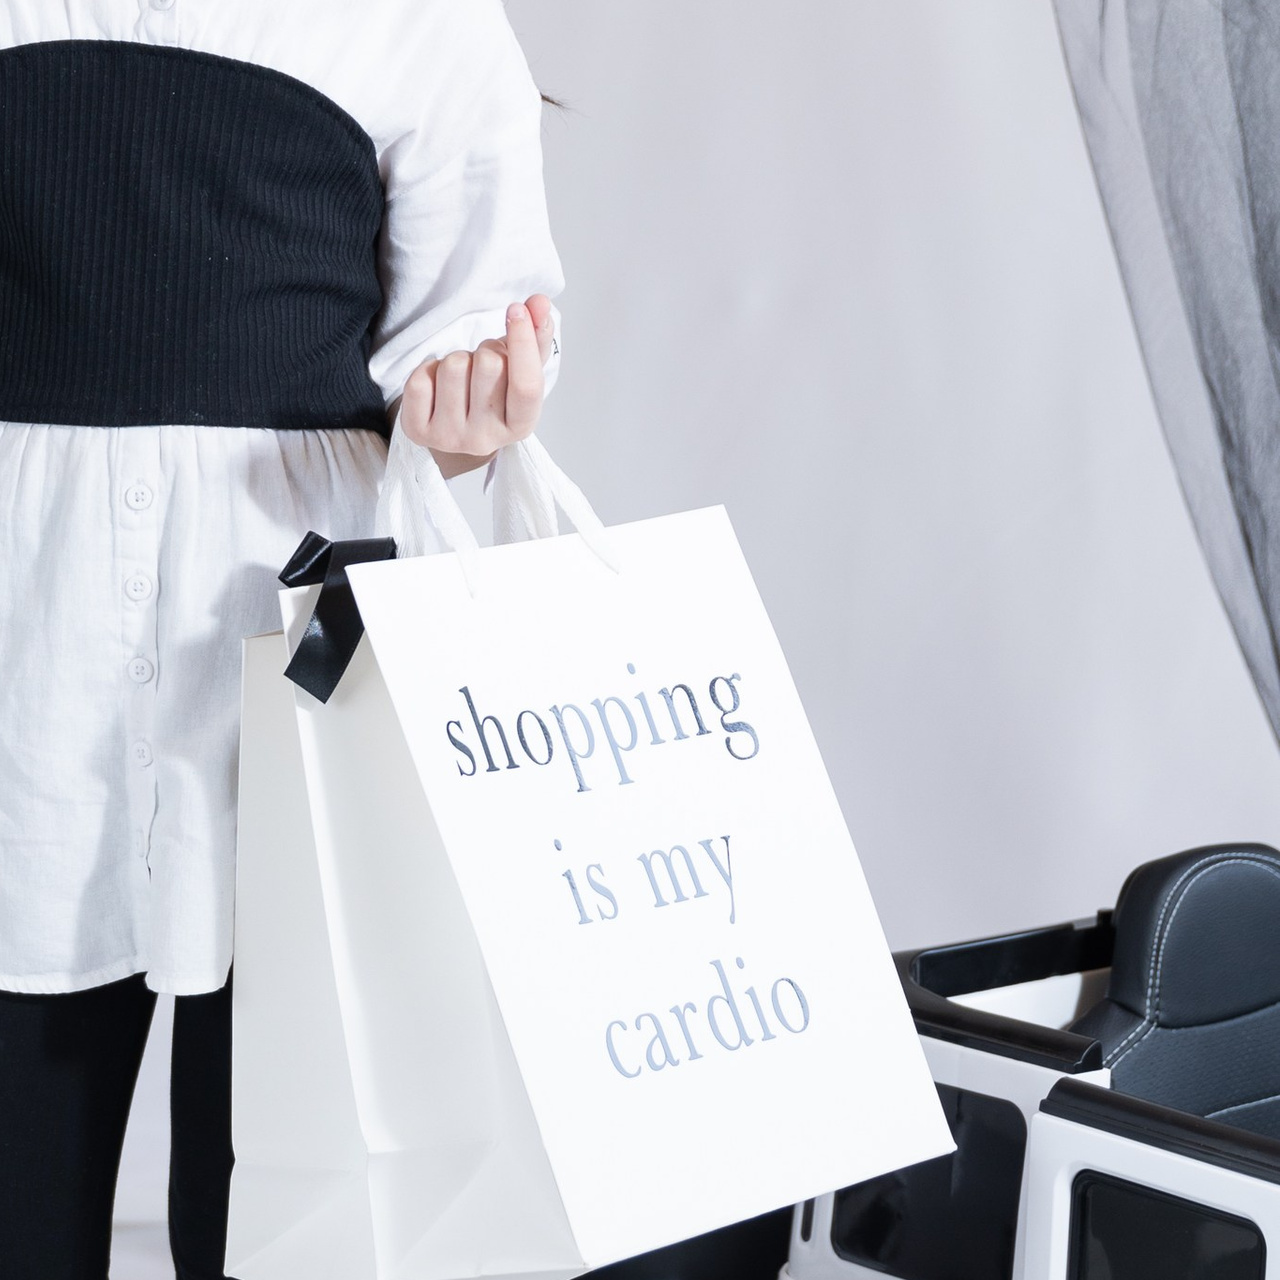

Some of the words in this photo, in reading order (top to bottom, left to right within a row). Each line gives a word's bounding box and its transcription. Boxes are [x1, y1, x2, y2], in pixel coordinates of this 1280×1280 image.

[445, 662, 760, 793] shopping
[553, 838, 619, 925] is
[637, 835, 736, 925] my
[605, 956, 811, 1078] cardio
